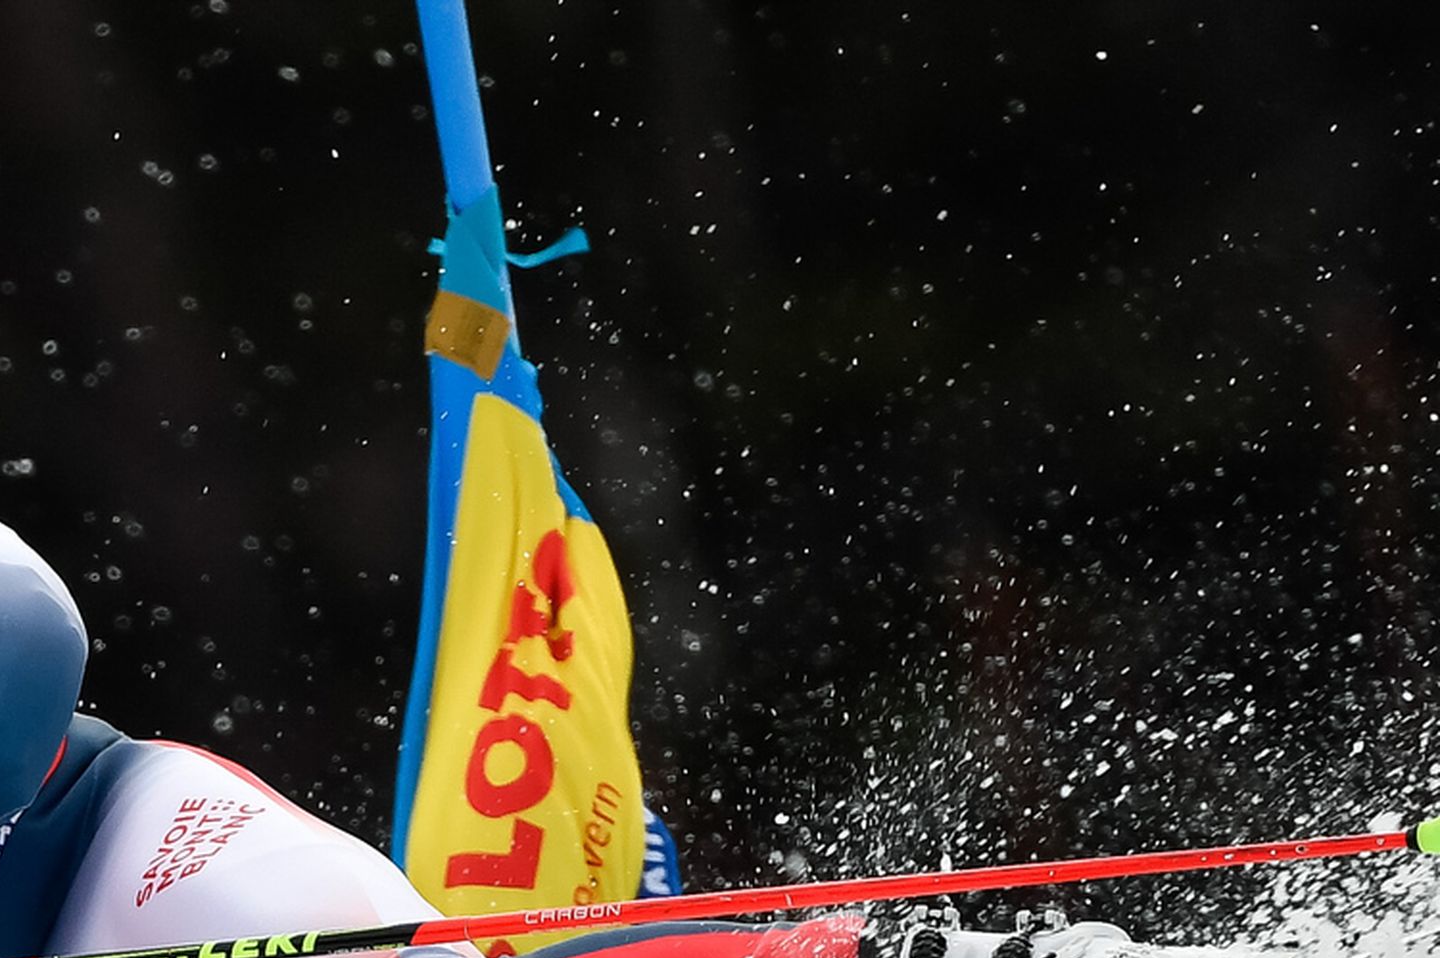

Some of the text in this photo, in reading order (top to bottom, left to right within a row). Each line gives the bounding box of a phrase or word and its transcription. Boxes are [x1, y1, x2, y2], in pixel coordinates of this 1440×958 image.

[136, 798, 208, 908] SAVOIE
[155, 814, 223, 894] MONT
[179, 804, 266, 880] BLANC
[524, 902, 622, 925] CARBON
